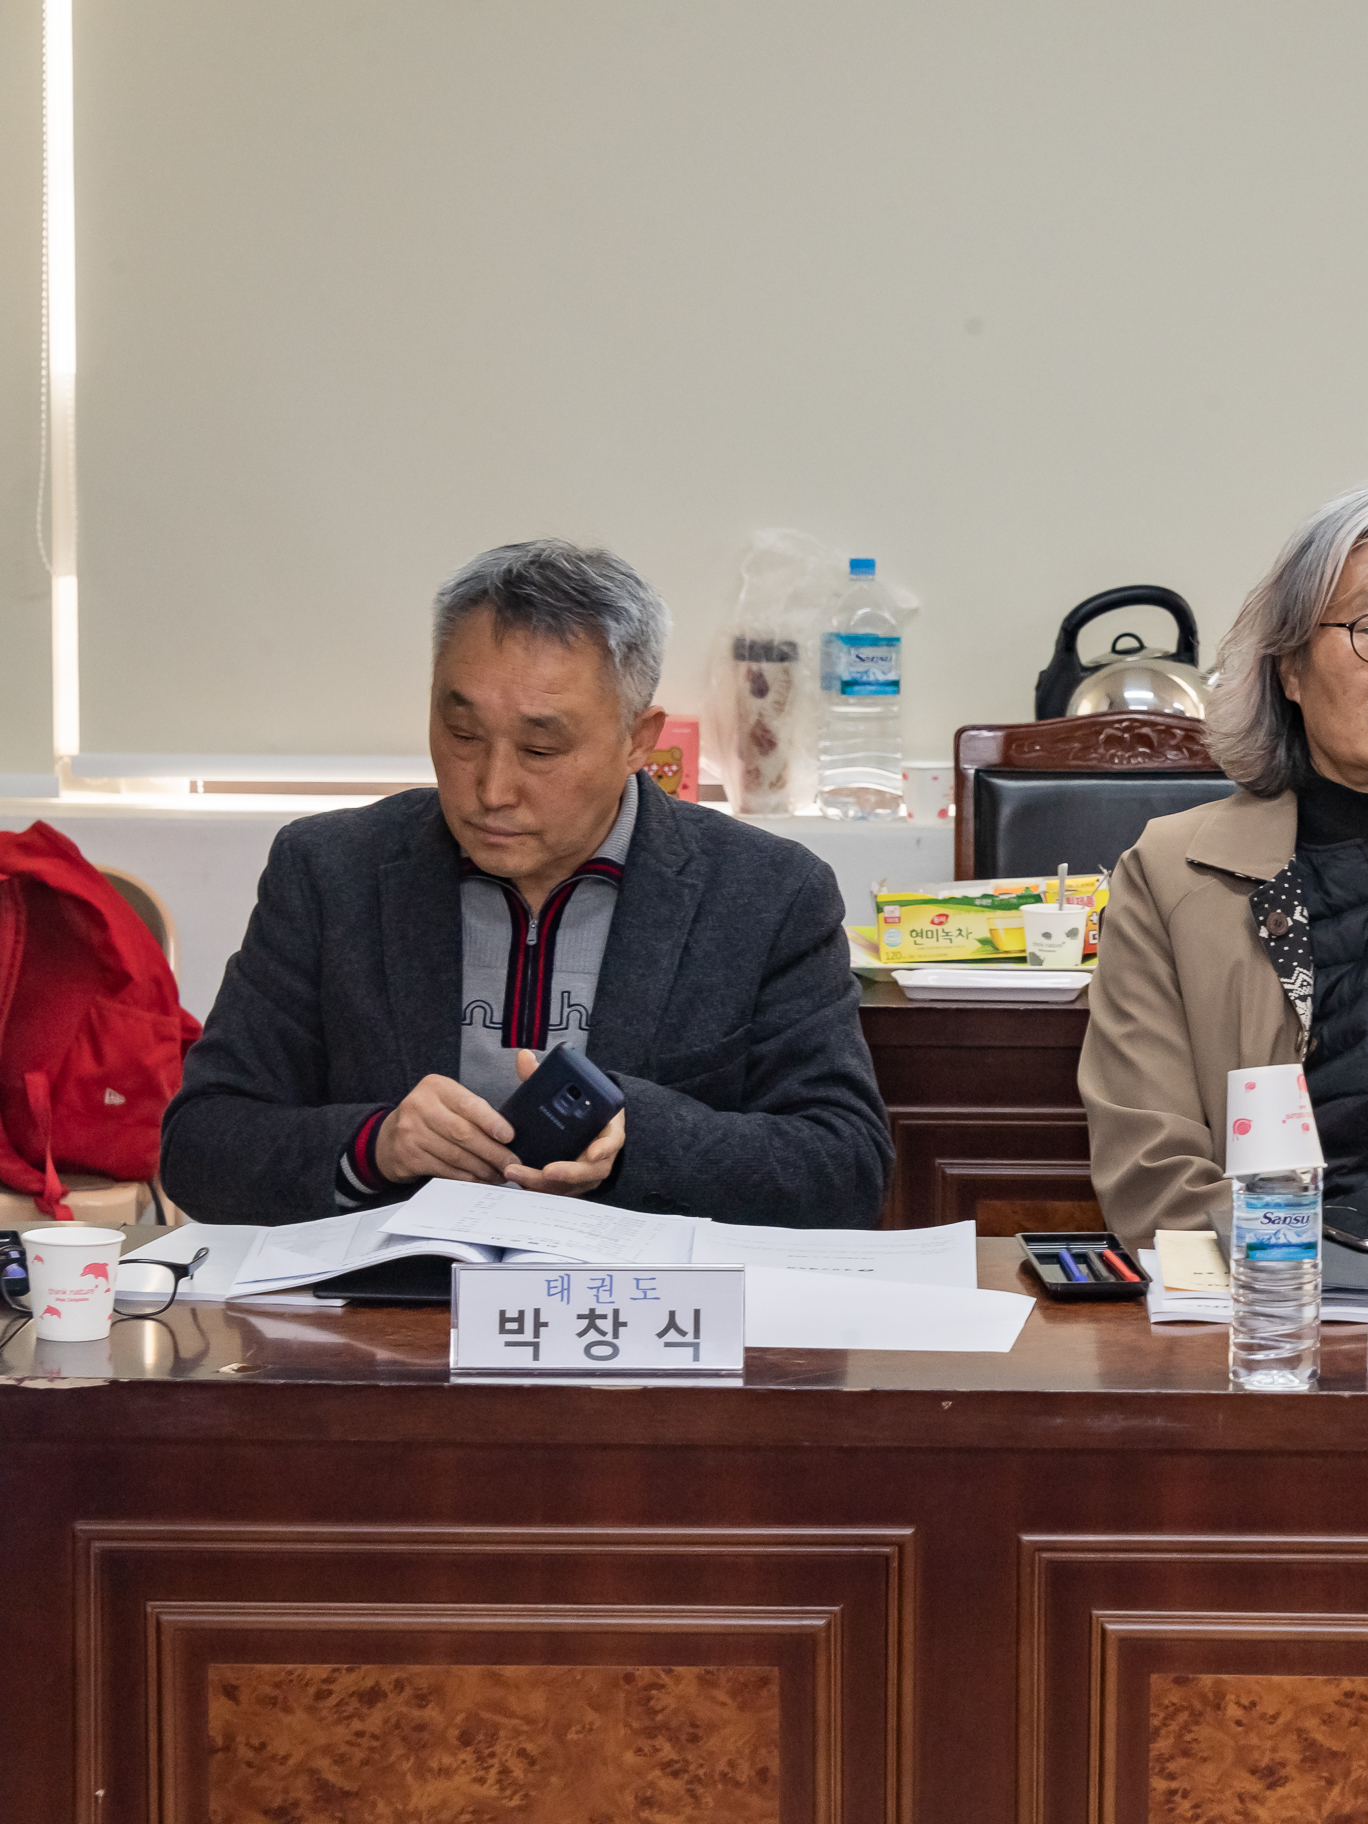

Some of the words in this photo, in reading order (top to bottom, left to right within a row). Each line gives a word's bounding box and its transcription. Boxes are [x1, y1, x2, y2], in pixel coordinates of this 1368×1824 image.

[909, 927, 973, 946] 현미녹차
[1260, 1211, 1310, 1225] Sansu
[69, 1288, 95, 1296] nature
[544, 1273, 661, 1305] 태권도
[498, 1307, 702, 1362] 박창식
